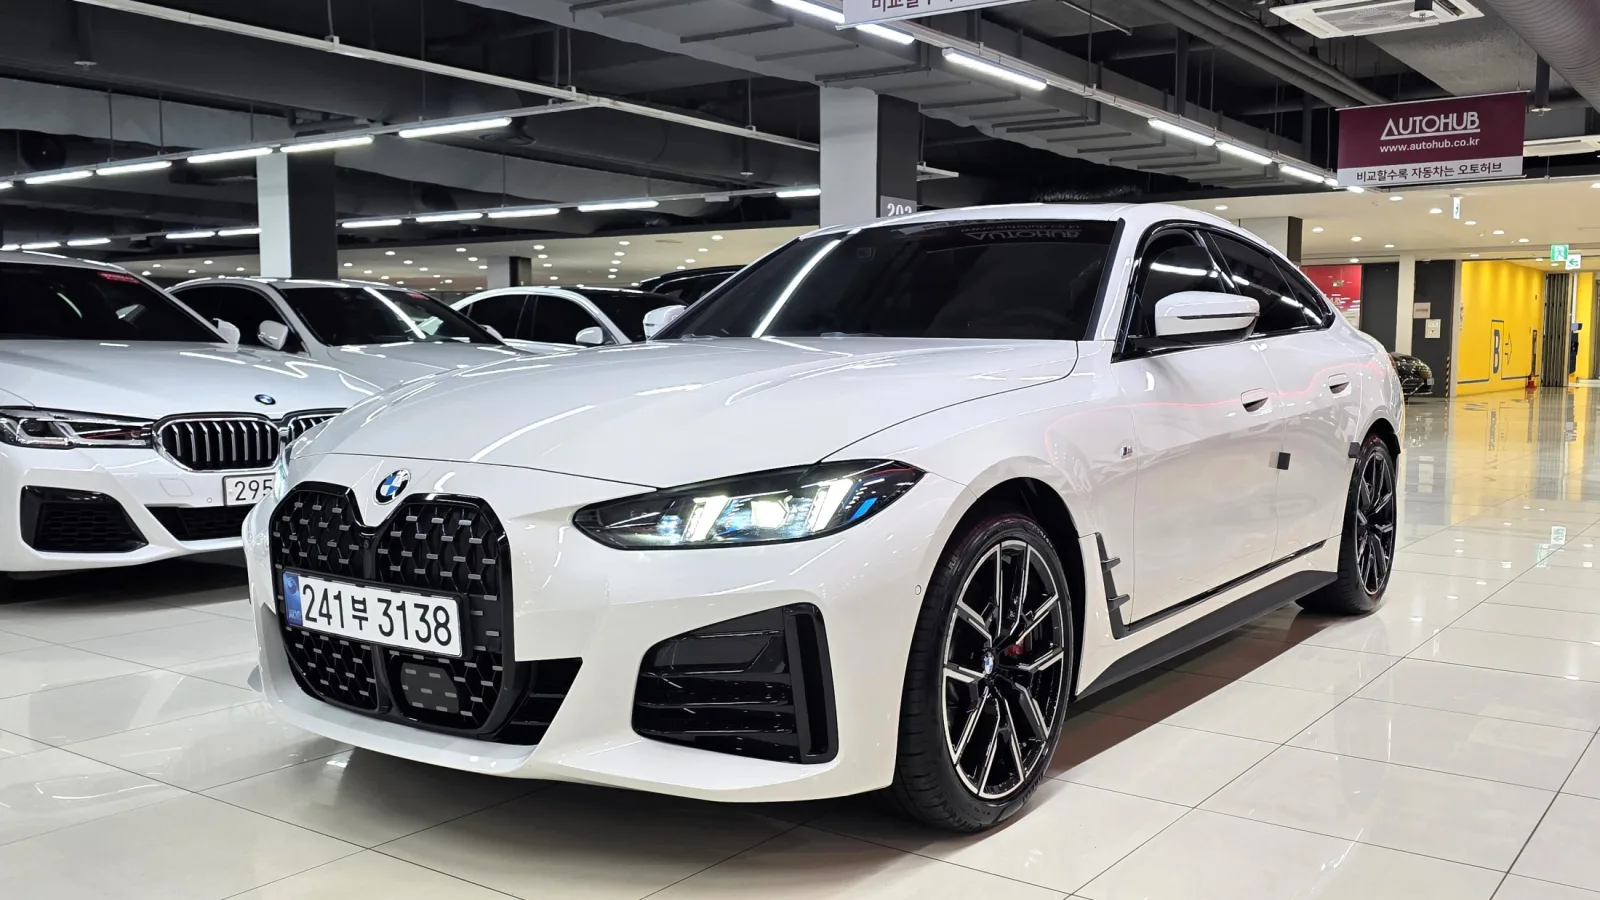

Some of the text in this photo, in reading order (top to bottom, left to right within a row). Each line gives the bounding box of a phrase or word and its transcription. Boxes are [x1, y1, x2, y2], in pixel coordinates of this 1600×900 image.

[1380, 111, 1481, 141] AUTOHUB
[1379, 137, 1481, 153] www.autohub.co.kr
[1356, 162, 1503, 183] 비교할수록 자동차는 오토허브
